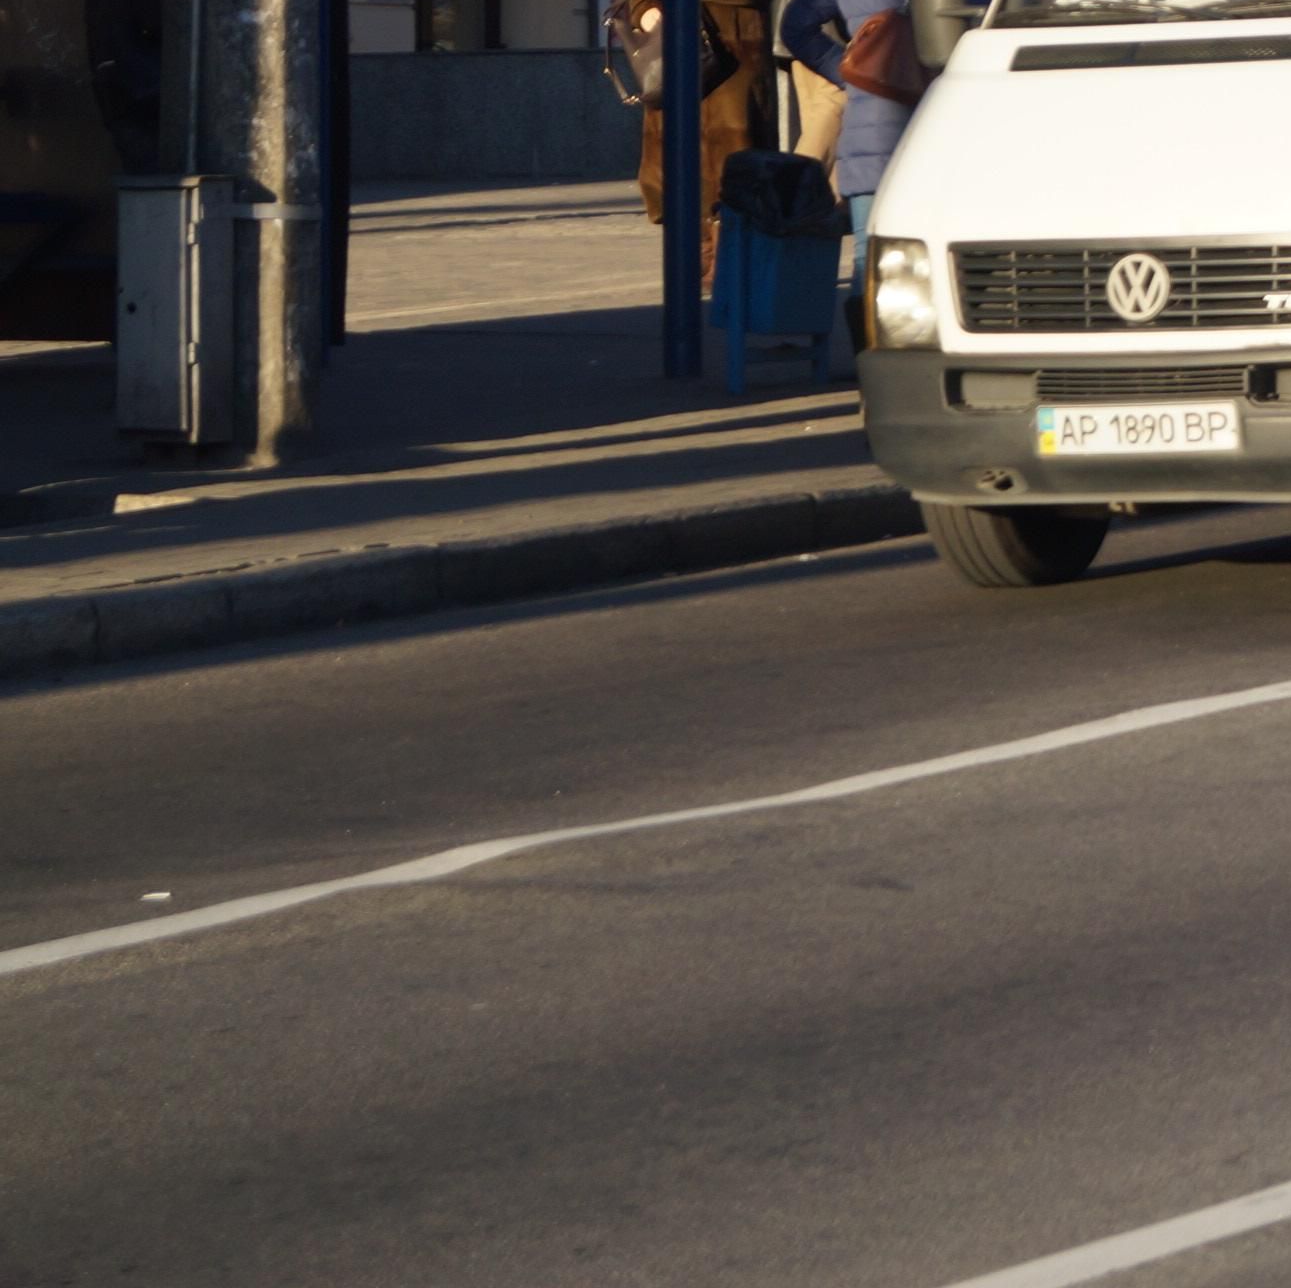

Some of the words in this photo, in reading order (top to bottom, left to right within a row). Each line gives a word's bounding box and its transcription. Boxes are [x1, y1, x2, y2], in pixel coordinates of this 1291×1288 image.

[1061, 415, 1098, 446] AP
[1109, 413, 1176, 444] 1890
[1183, 411, 1228, 443] BP
